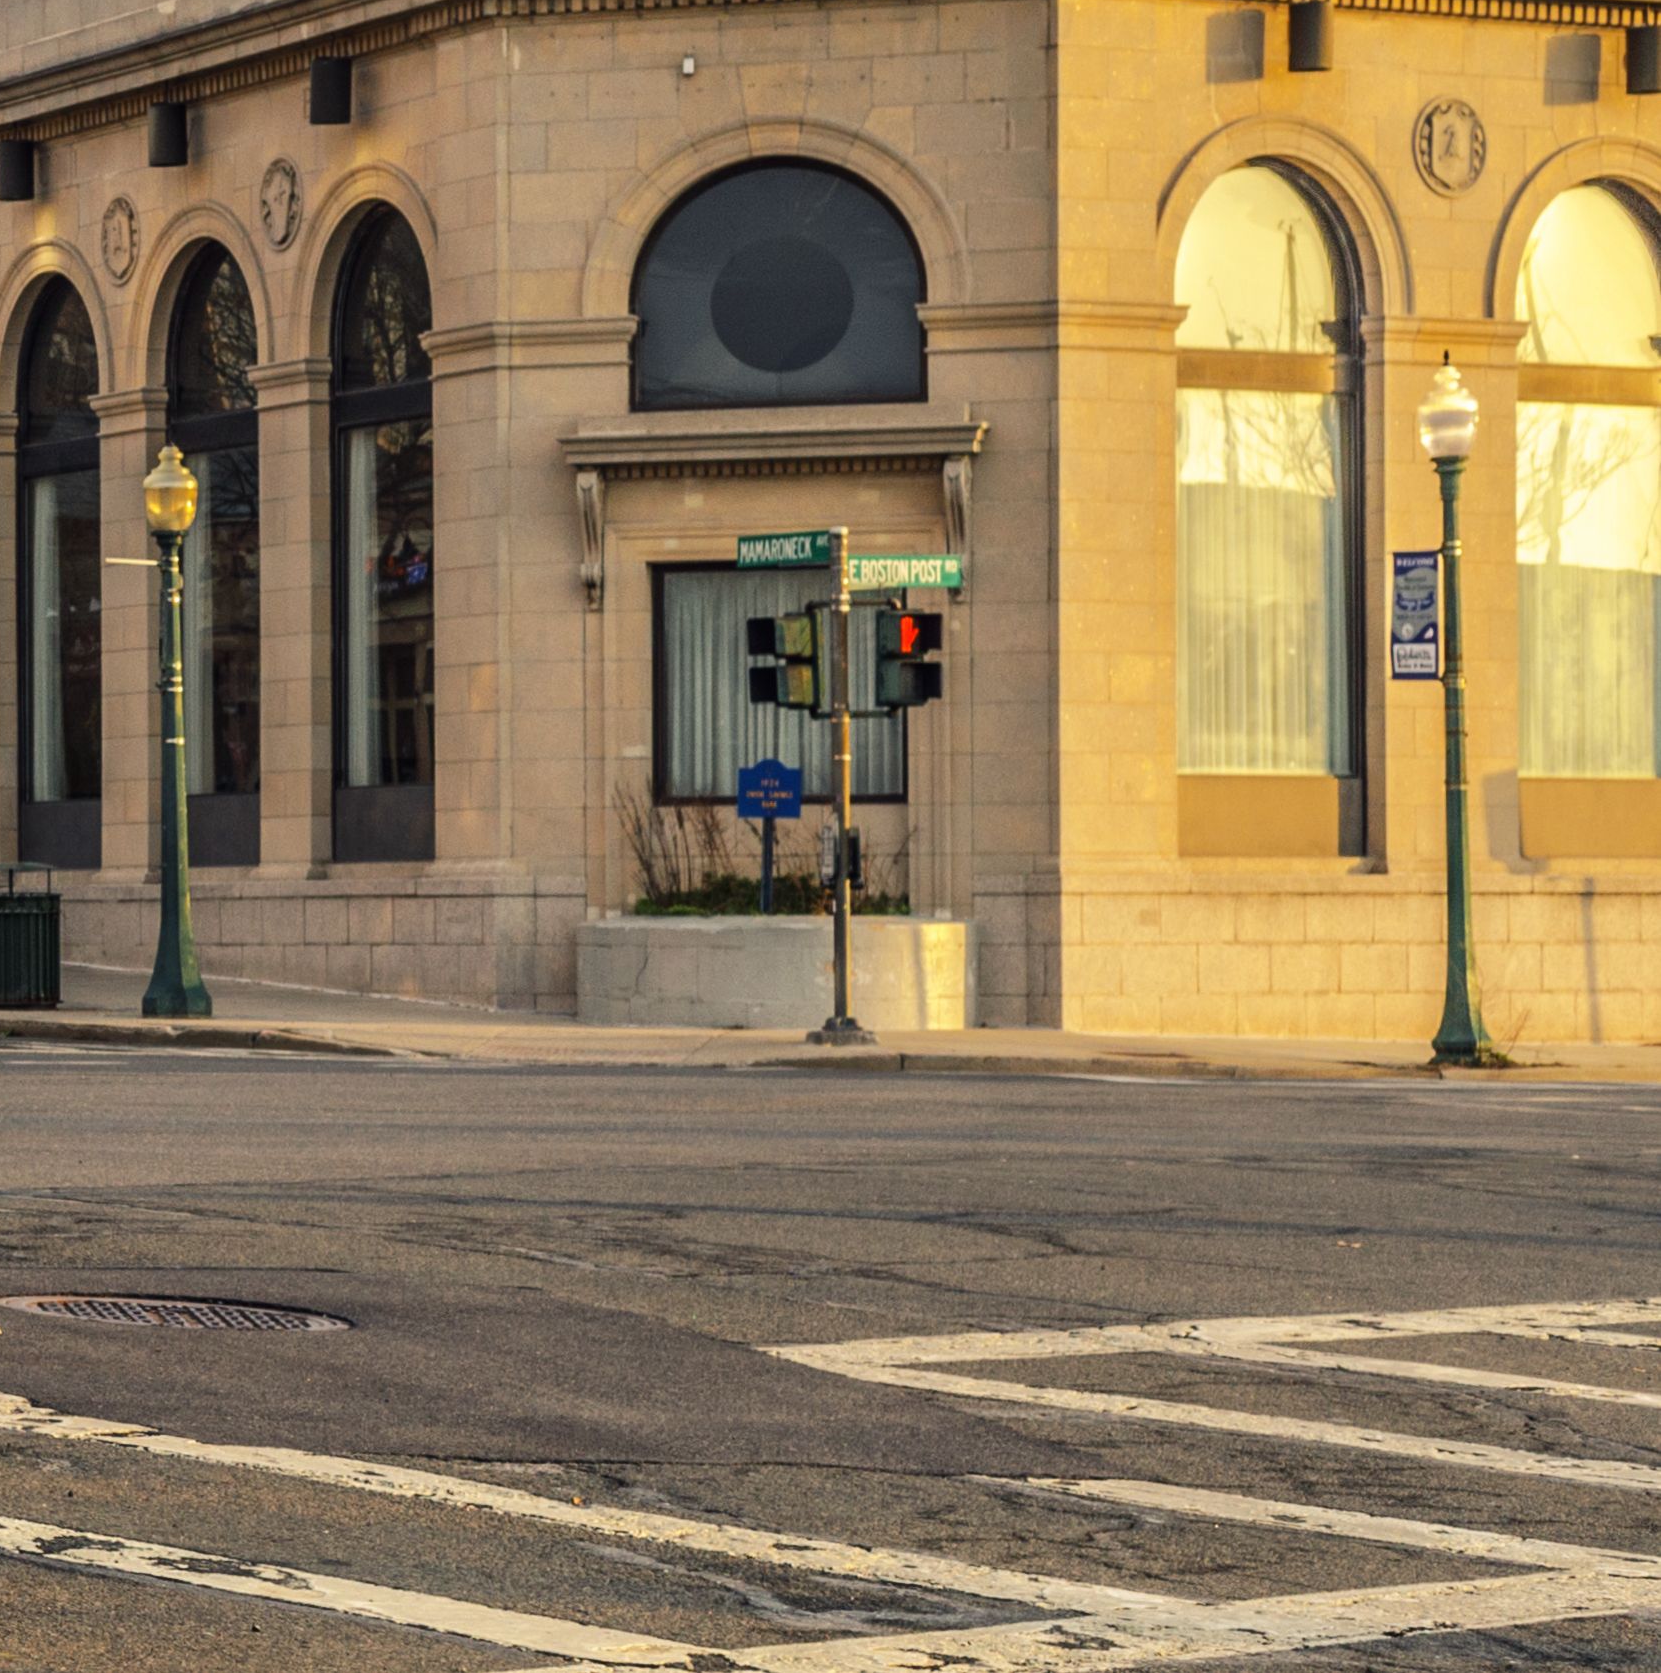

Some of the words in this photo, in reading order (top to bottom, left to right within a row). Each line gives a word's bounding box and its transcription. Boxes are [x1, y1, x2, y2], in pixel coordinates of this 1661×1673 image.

[739, 534, 812, 563] MAMARONECK
[861, 559, 909, 584] BOSTON
[911, 559, 943, 583] POST
[944, 560, 957, 573] RD
[1396, 556, 1434, 567] WELCOME
